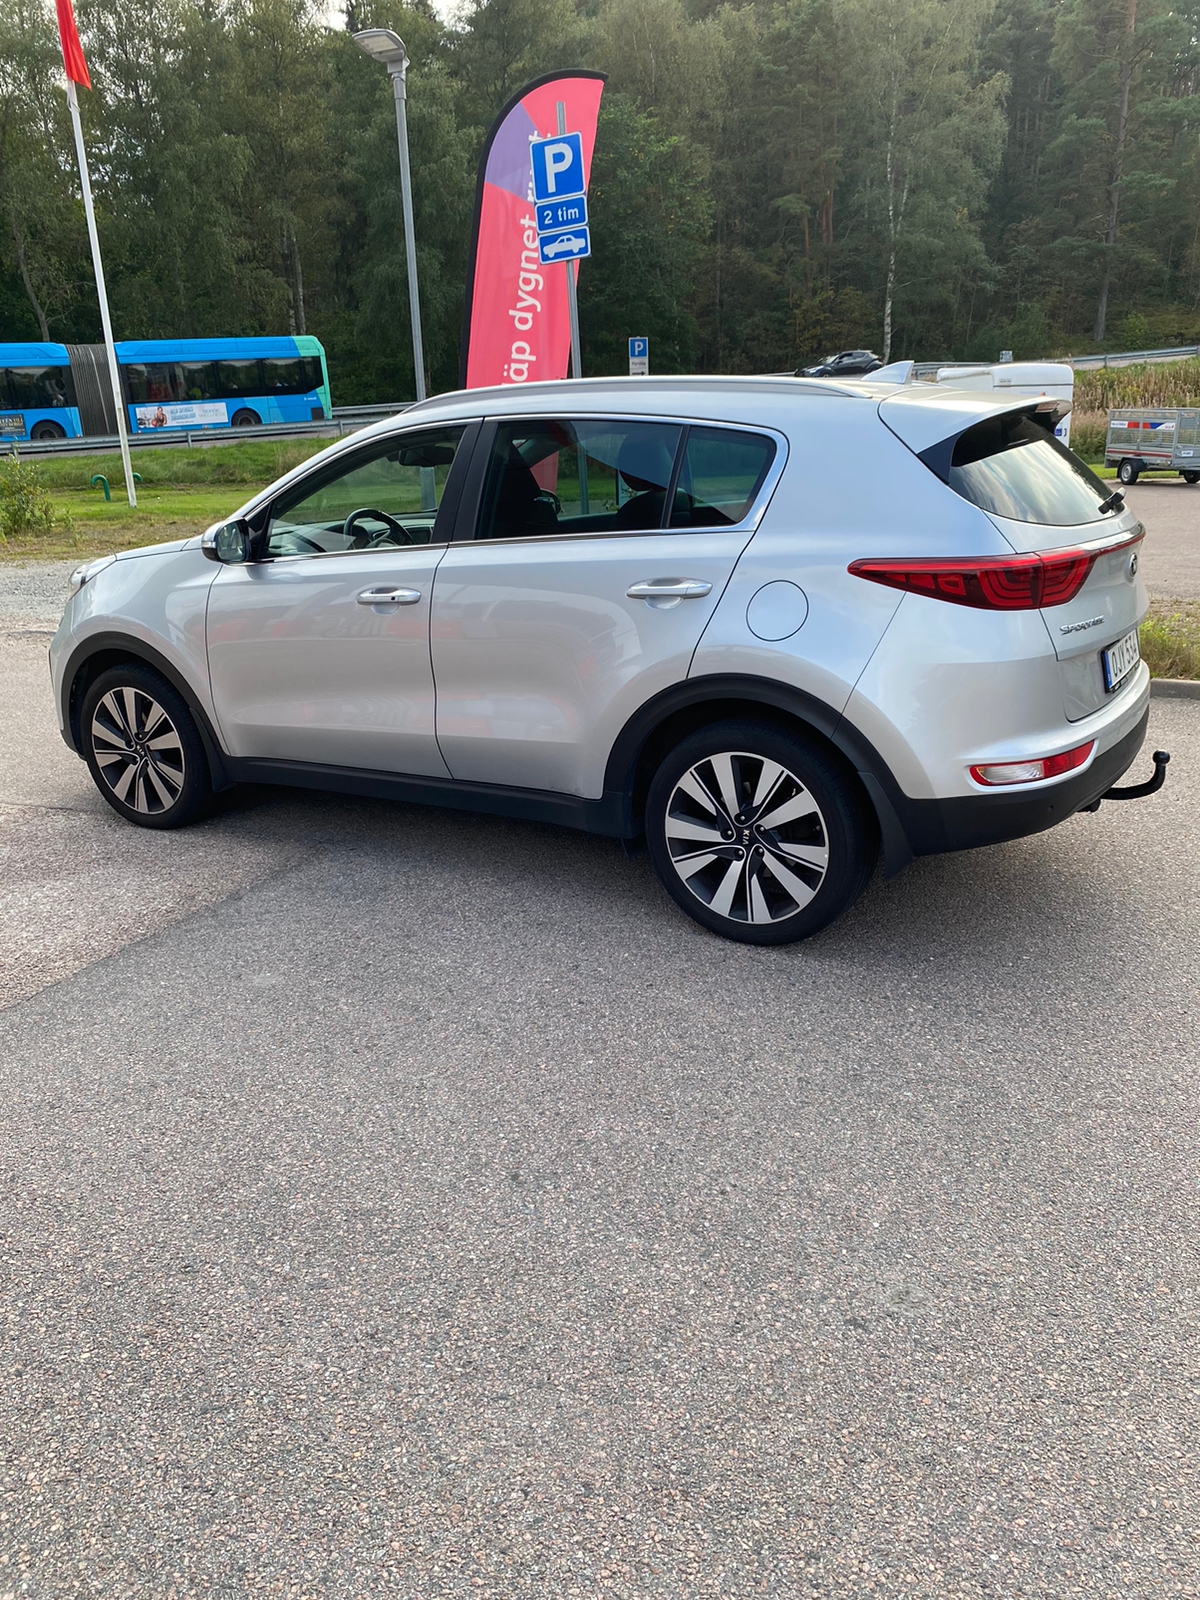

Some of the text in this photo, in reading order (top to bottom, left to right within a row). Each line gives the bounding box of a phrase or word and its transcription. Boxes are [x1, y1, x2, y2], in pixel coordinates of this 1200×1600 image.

[544, 142, 573, 194] P
[543, 206, 580, 225] 2 tim
[509, 213, 544, 331] dygnet
[502, 341, 537, 385] äp
[634, 341, 644, 356] P
[742, 829, 750, 845] KIA
